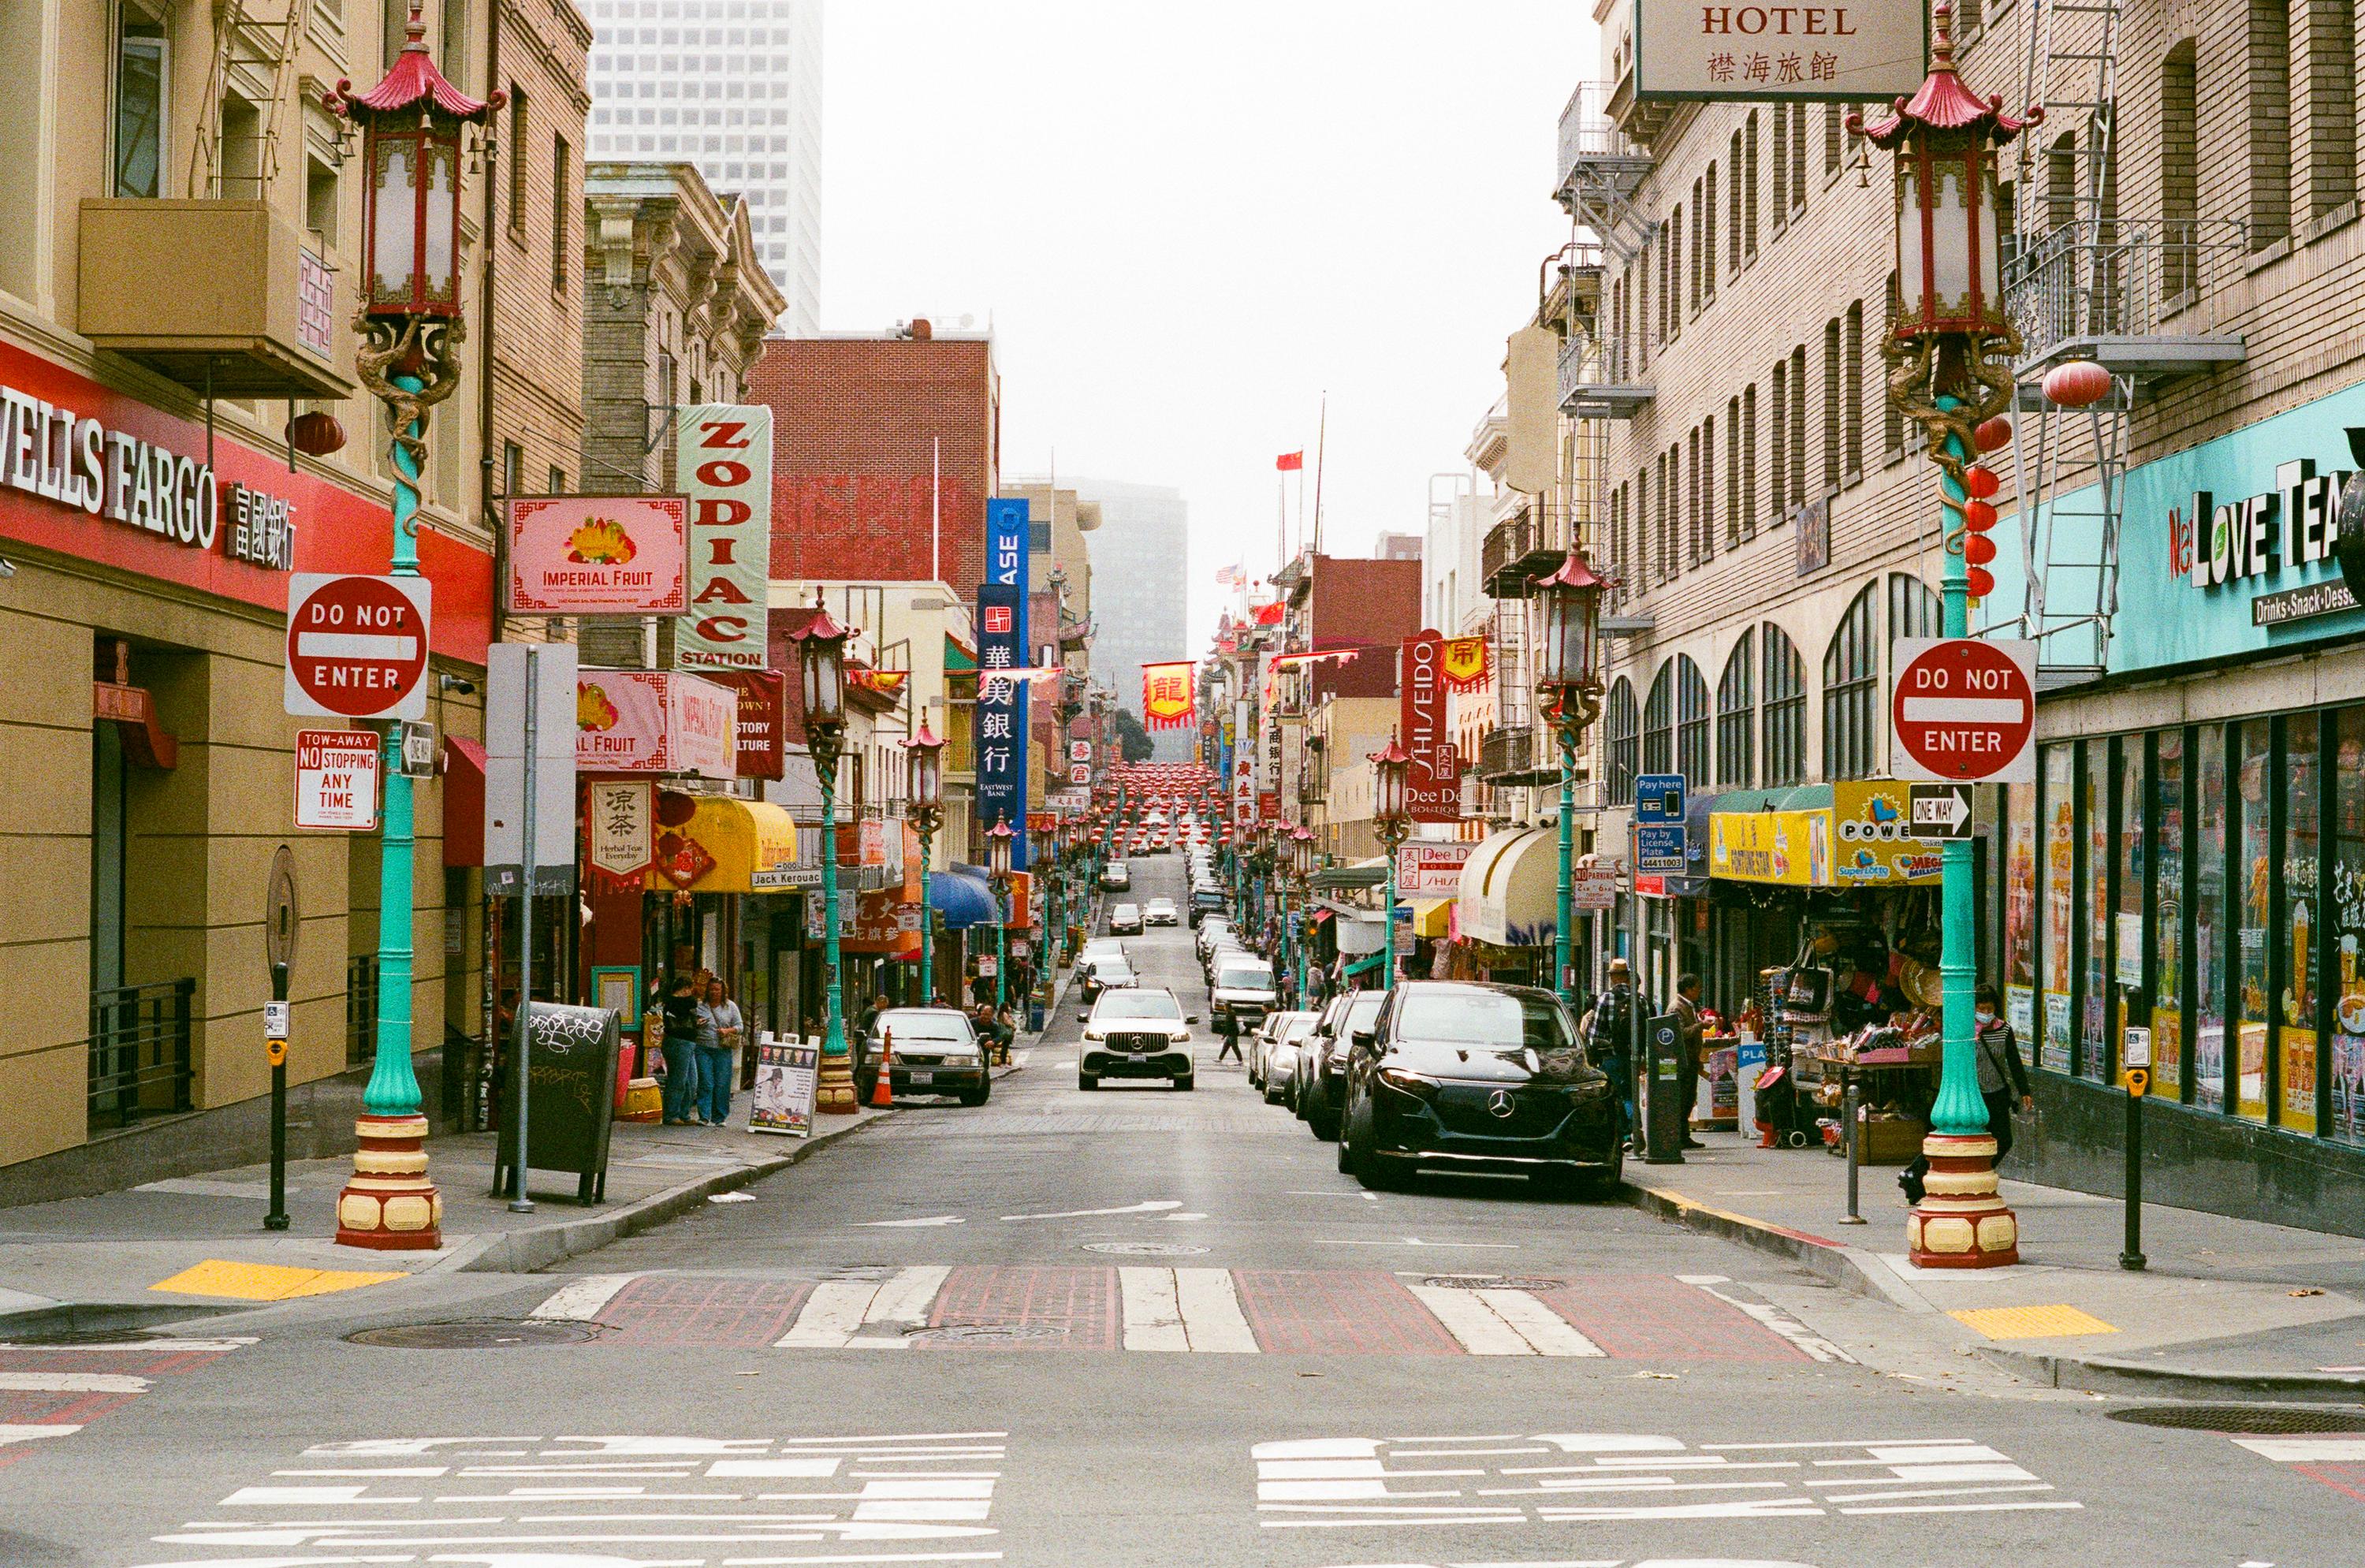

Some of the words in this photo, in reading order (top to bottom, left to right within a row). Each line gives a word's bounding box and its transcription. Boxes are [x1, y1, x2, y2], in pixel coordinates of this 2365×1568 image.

[1701, 6, 1857, 35] HOTEL
[114, 430, 218, 549] FARGO
[2191, 490, 2267, 588] LOVE
[2276, 459, 2341, 568] TEA
[692, 422, 752, 642] ZODIAC
[999, 534, 1019, 585] ASE
[543, 571, 609, 586] IMPERIAL
[613, 571, 653, 586] FRUIT
[2256, 597, 2286, 624] Drinks
[2291, 588, 2321, 616] Snack
[311, 603, 344, 624] DO
[356, 605, 405, 627] NOT
[680, 652, 762, 665] STATION
[315, 665, 399, 688] ENTER
[1916, 668, 1949, 689] DO
[1966, 669, 2013, 690] NOT
[1153, 676, 1186, 702] 龍
[982, 645, 1012, 773] 華美銀行
[1410, 642, 1433, 781] SHISEIDO
[736, 721, 770, 734] STORY
[305, 734, 372, 747] TOW-AWAY
[594, 736, 635, 751] FRUIT
[736, 739, 770, 750] LTURE
[1924, 731, 2002, 752] ENTER
[300, 747, 319, 768] NO
[324, 753, 374, 769] STOPPING
[322, 773, 352, 788] ANY
[1639, 780, 1658, 791] Pay
[319, 792, 353, 808] TIME
[1406, 788, 1438, 803] Dee
[1916, 801, 1932, 821] ONE
[1935, 801, 1953, 821] WAY
[1641, 830, 1657, 839] Pay
[1659, 829, 1670, 839] by
[1845, 825, 1909, 837] POWE
[1423, 847, 1451, 860] Dee
[754, 874, 777, 885] Jack
[780, 873, 820, 883] Kerouac
[1576, 870, 1587, 881] NO
[1741, 1050, 1765, 1060] PLA
